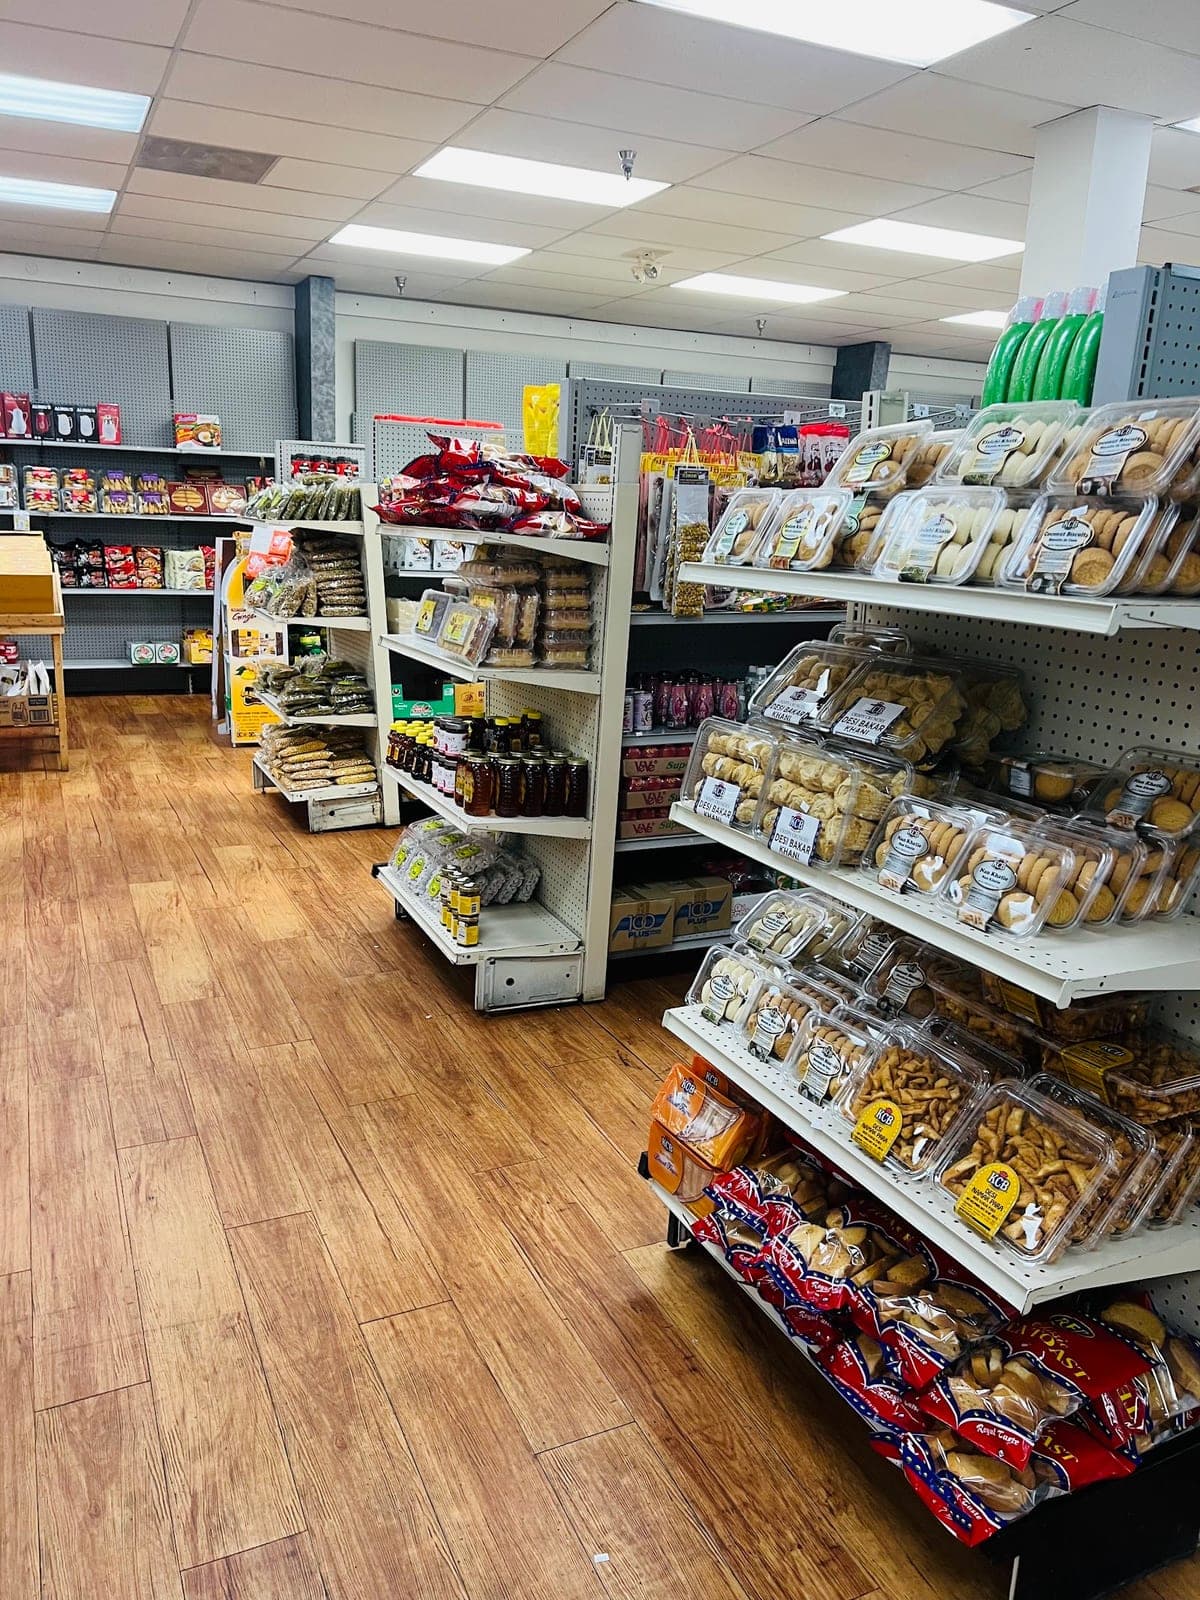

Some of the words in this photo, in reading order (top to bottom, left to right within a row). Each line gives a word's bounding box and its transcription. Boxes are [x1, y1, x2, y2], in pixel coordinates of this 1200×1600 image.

[770, 703, 785, 711] DESI
[772, 711, 793, 721] KHANI
[841, 716, 857, 724] DESI
[857, 720, 886, 731] BAKAR
[844, 726, 870, 735] KHANI
[698, 800, 711, 810] DESI
[711, 804, 732, 819] BAKAR
[789, 815, 805, 831] KCB
[774, 833, 789, 845] DESI
[789, 838, 812, 855] BAKAR
[779, 846, 801, 860] KHANI
[689, 901, 713, 917] 100
[629, 914, 655, 931] 100
[628, 930, 650, 938] PLUS
[705, 1071, 719, 1086] KCB
[681, 1080, 696, 1095] KCB
[876, 1110, 895, 1126] KCB
[988, 1172, 1010, 1191] KCB
[984, 1188, 998, 1199] DESI
[989, 1199, 1004, 1211] PARA
[975, 1423, 997, 1436] Royal
[997, 1429, 1020, 1446] Taste
[961, 1499, 983, 1520] Taste
